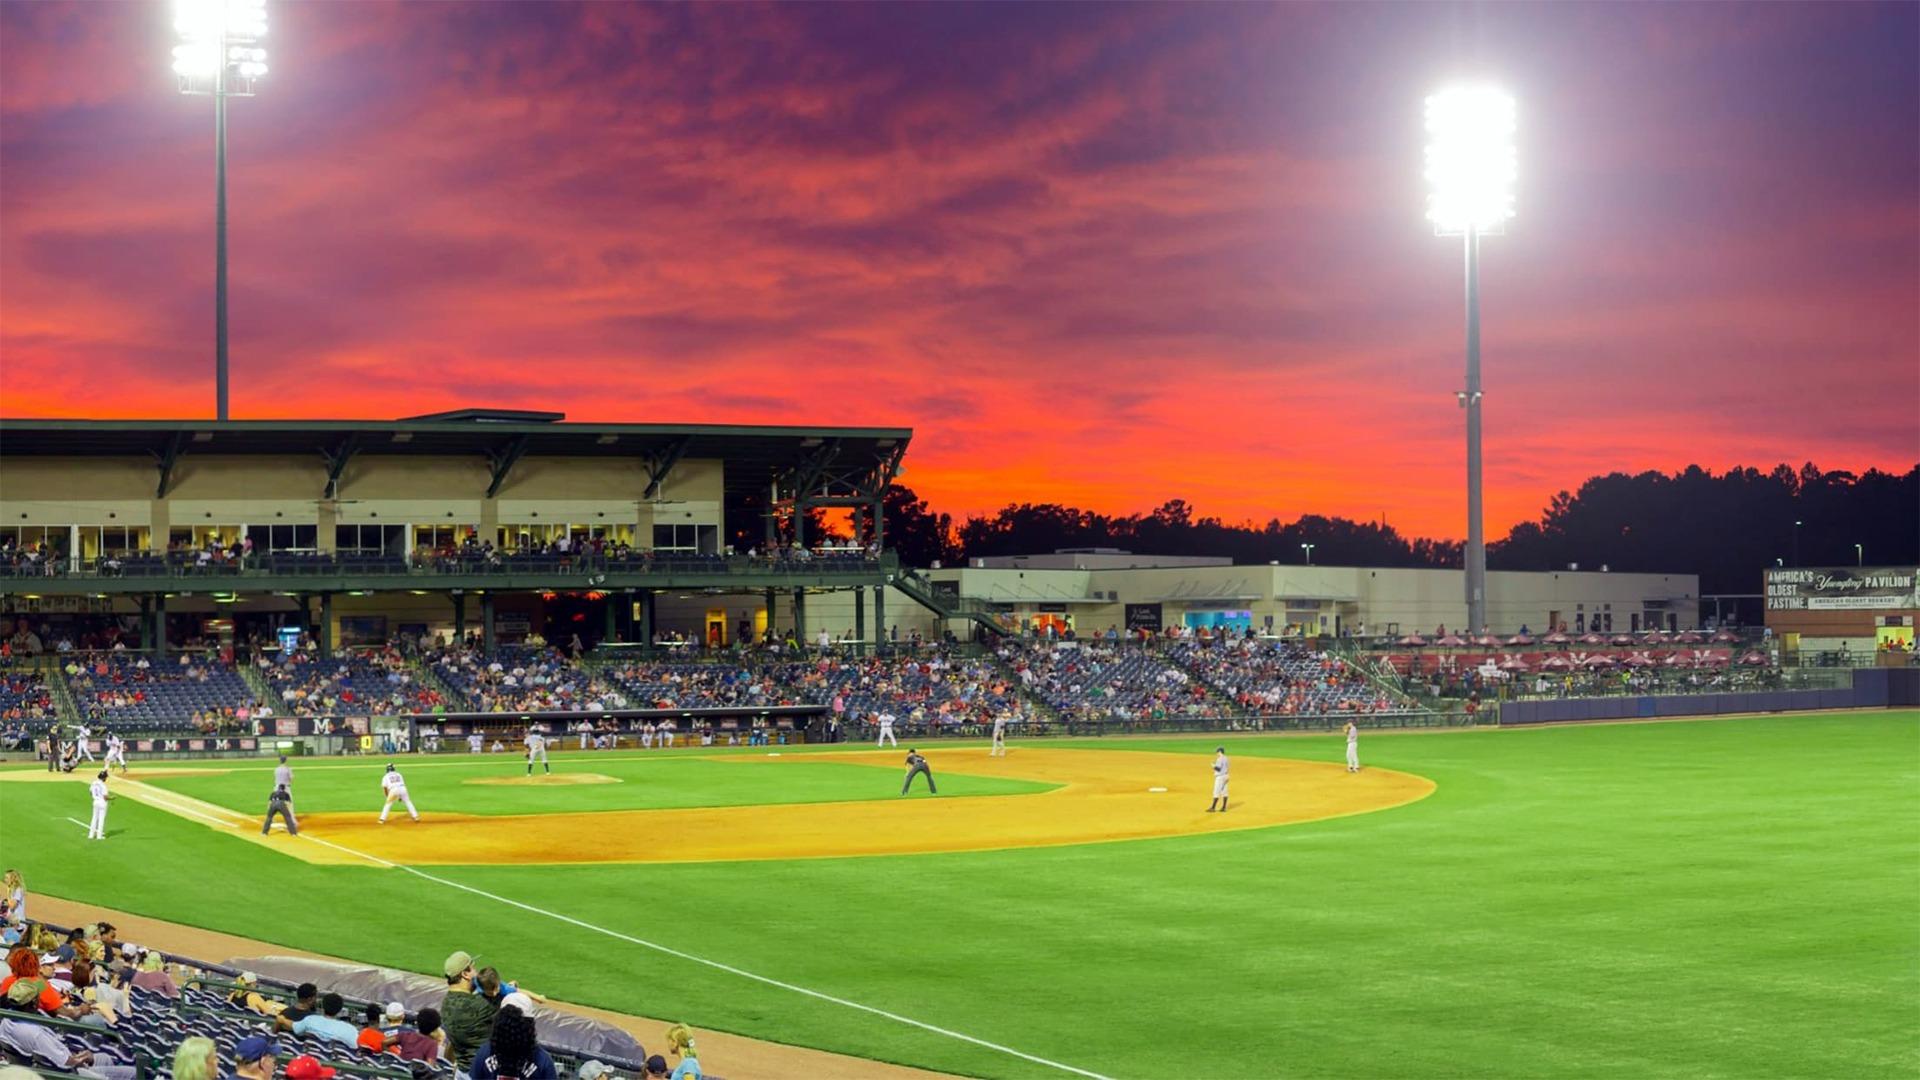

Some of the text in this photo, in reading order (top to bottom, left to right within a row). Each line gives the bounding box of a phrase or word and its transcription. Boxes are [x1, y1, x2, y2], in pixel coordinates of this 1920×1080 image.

[1768, 570, 1814, 583] AMERICA'S
[1865, 576, 1911, 588] PAVILION
[1768, 584, 1797, 596] OLDEST
[313, 718, 330, 735] M
